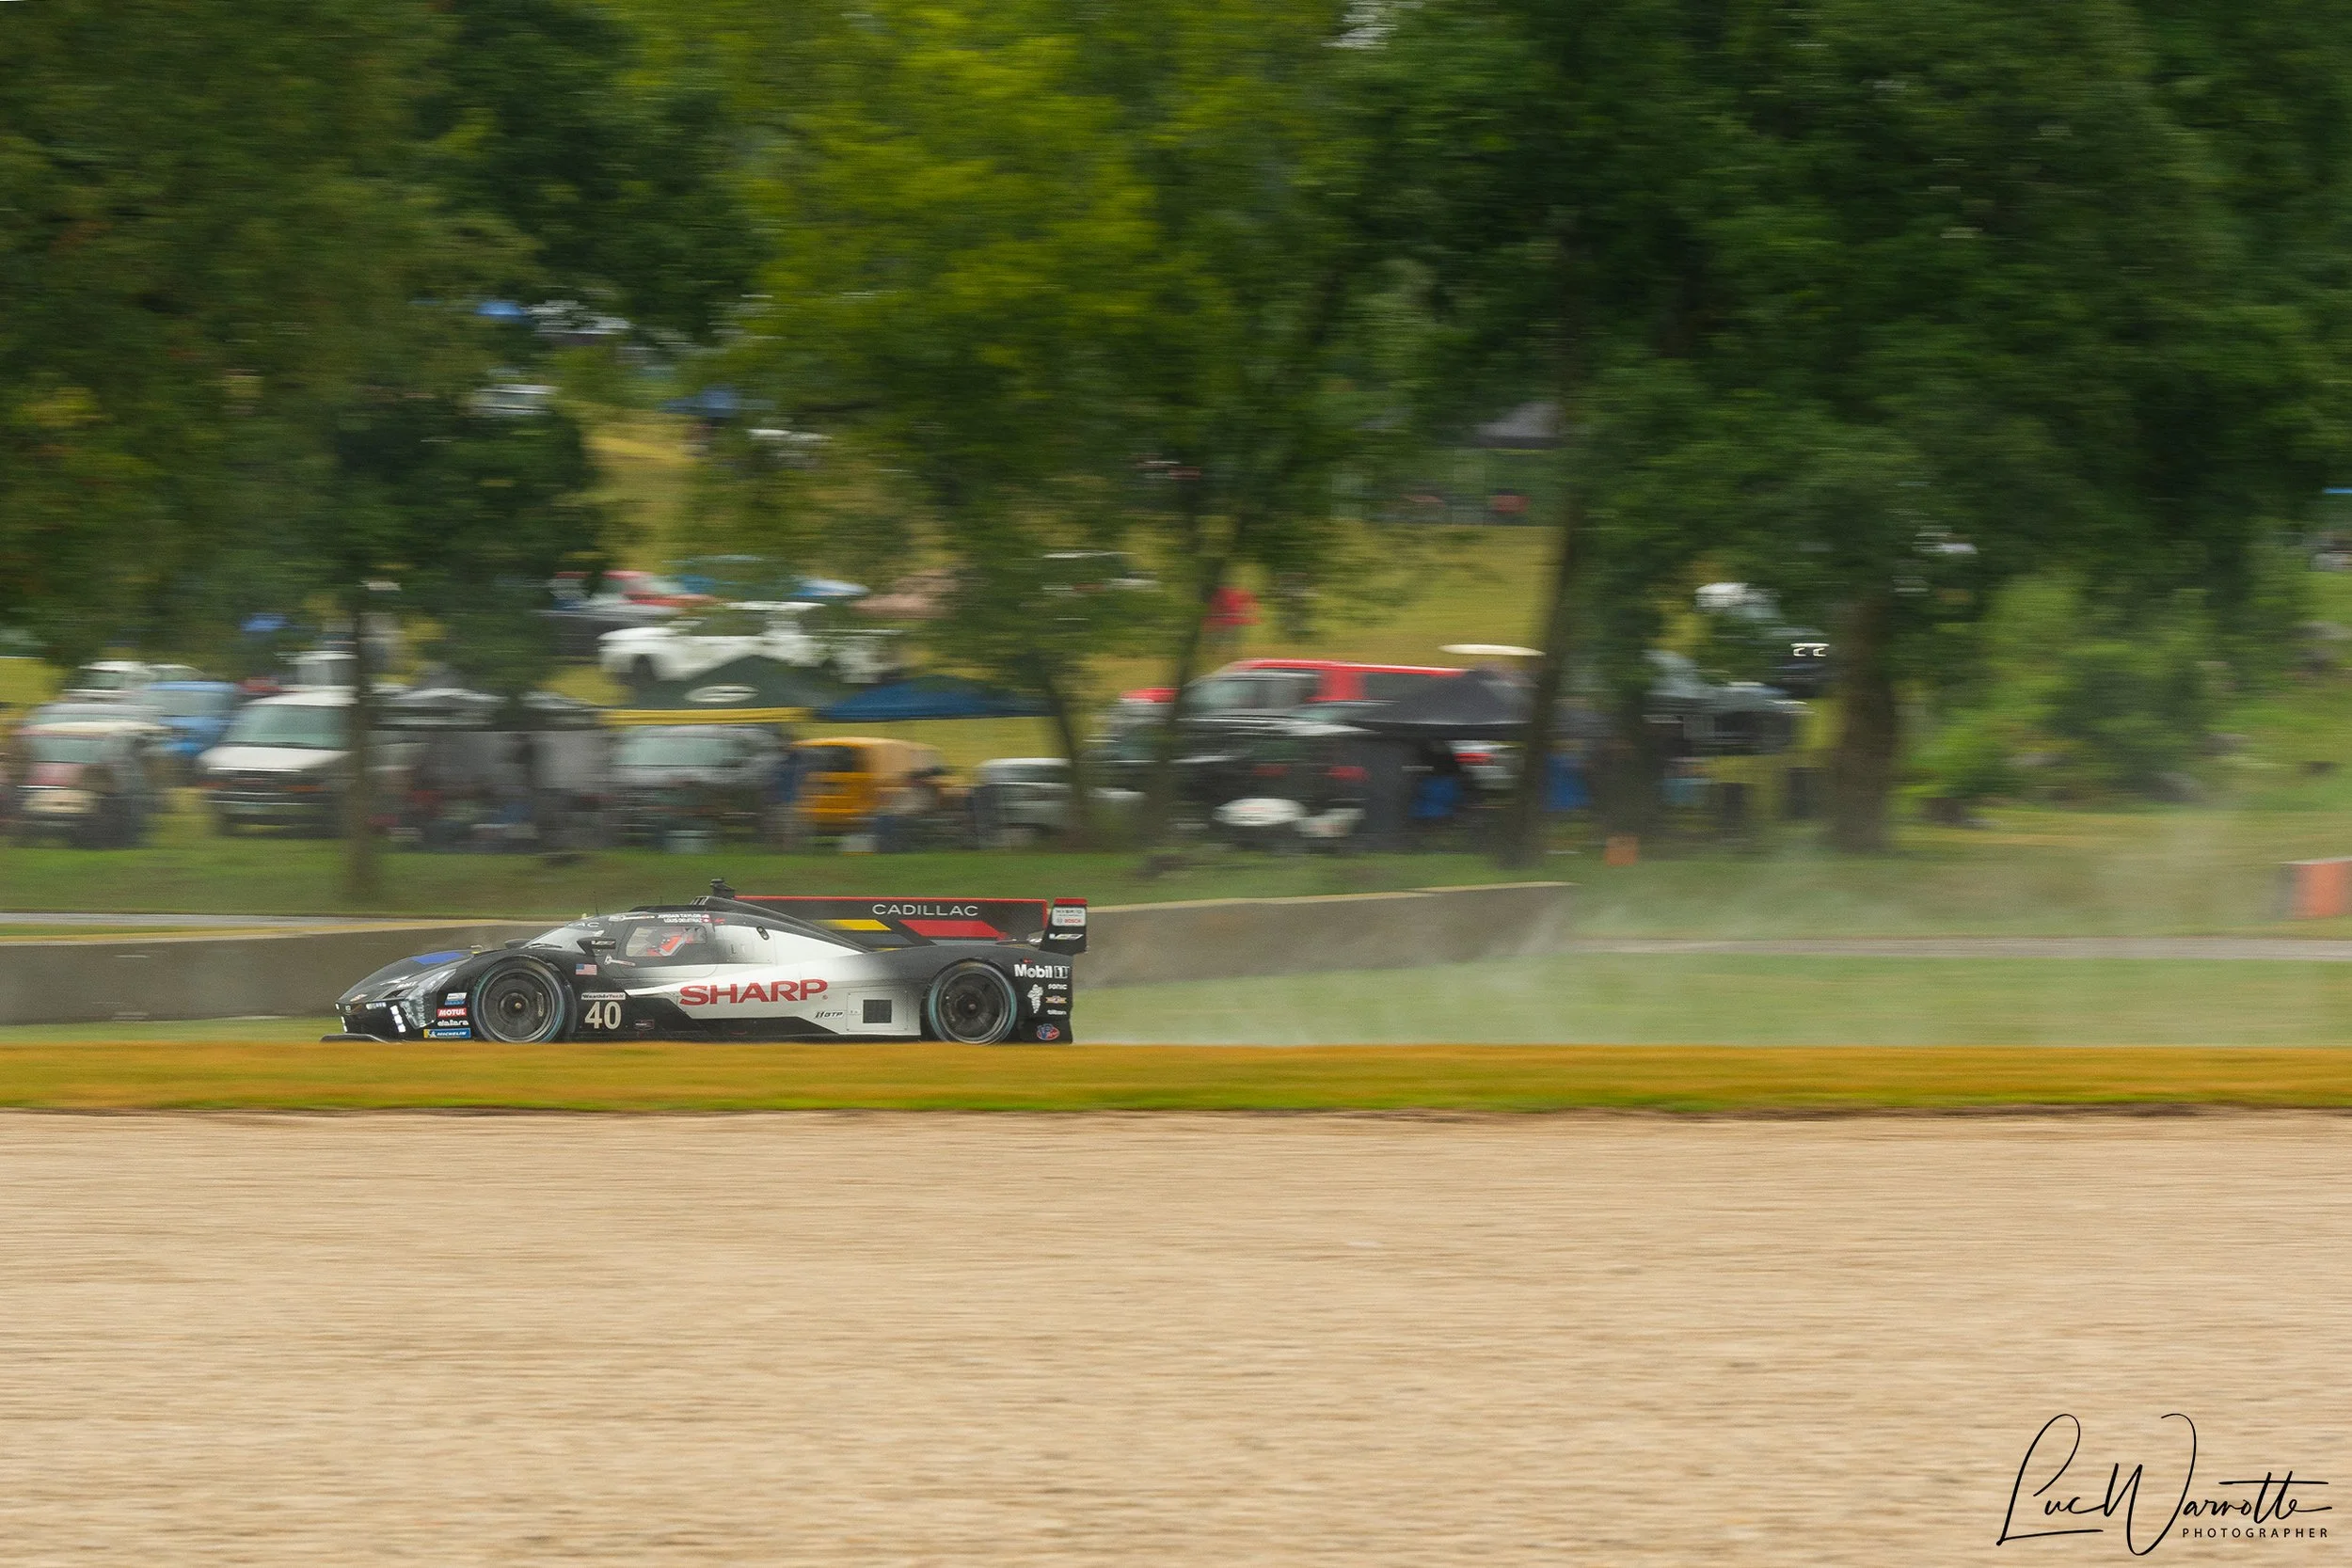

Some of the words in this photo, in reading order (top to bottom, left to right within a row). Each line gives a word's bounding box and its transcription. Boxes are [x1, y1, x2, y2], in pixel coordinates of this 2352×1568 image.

[871, 904, 978, 916] CADILLAC
[1014, 964, 1053, 978] Mobil
[679, 979, 828, 1006] SHARP
[437, 1008, 466, 1017] MOTUL
[584, 1001, 621, 1030] 40
